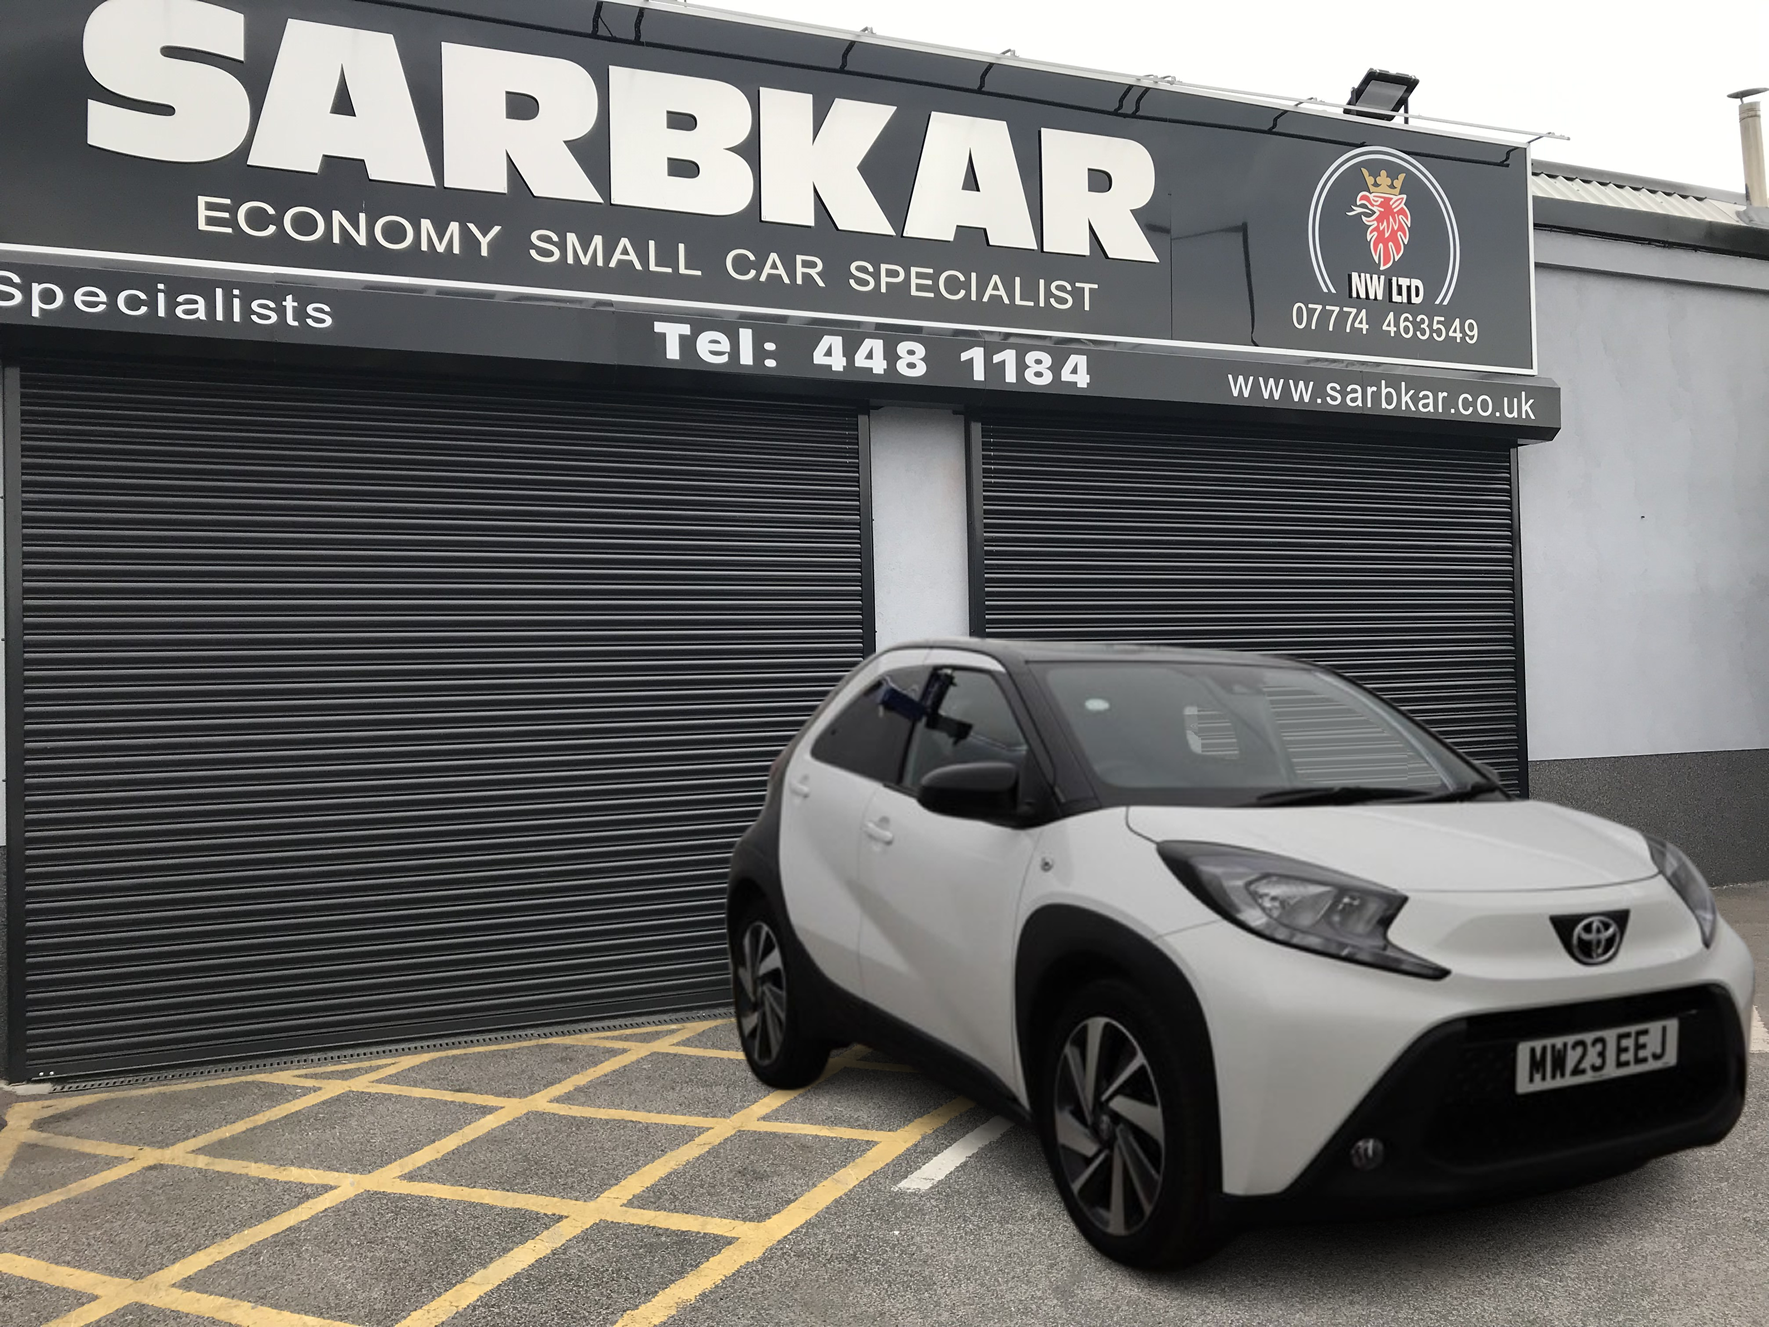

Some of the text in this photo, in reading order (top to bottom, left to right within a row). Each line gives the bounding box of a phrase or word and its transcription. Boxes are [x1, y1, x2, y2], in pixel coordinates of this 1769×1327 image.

[82, 0, 1160, 264] SARBKAR
[196, 195, 1100, 312] ECONOMY SMALL CAR SPECIALIST
[0, 270, 333, 328] Specialists
[1348, 271, 1425, 304] NW LTD
[1291, 302, 1479, 345] 07774 463549
[653, 320, 1091, 389] Tel: 448 1184
[1227, 373, 1536, 420] www.sarbkar.co.uk
[1529, 1024, 1668, 1085] MW23 EEJ
